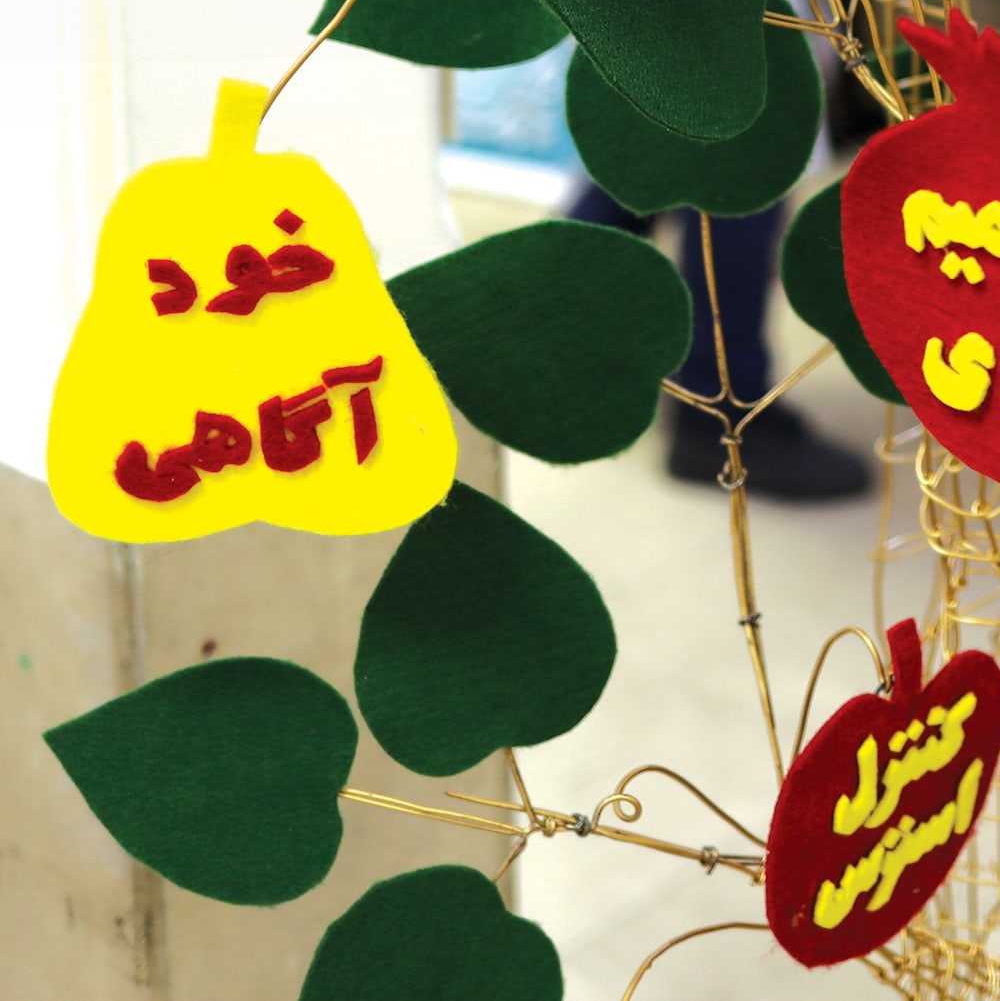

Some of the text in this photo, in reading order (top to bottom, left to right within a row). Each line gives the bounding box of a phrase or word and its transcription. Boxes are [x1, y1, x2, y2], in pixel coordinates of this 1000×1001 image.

[146, 208, 336, 317] خود
[114, 355, 384, 503] آگاهی
[832, 692, 978, 836] کنترل
[812, 758, 984, 930] استرس
